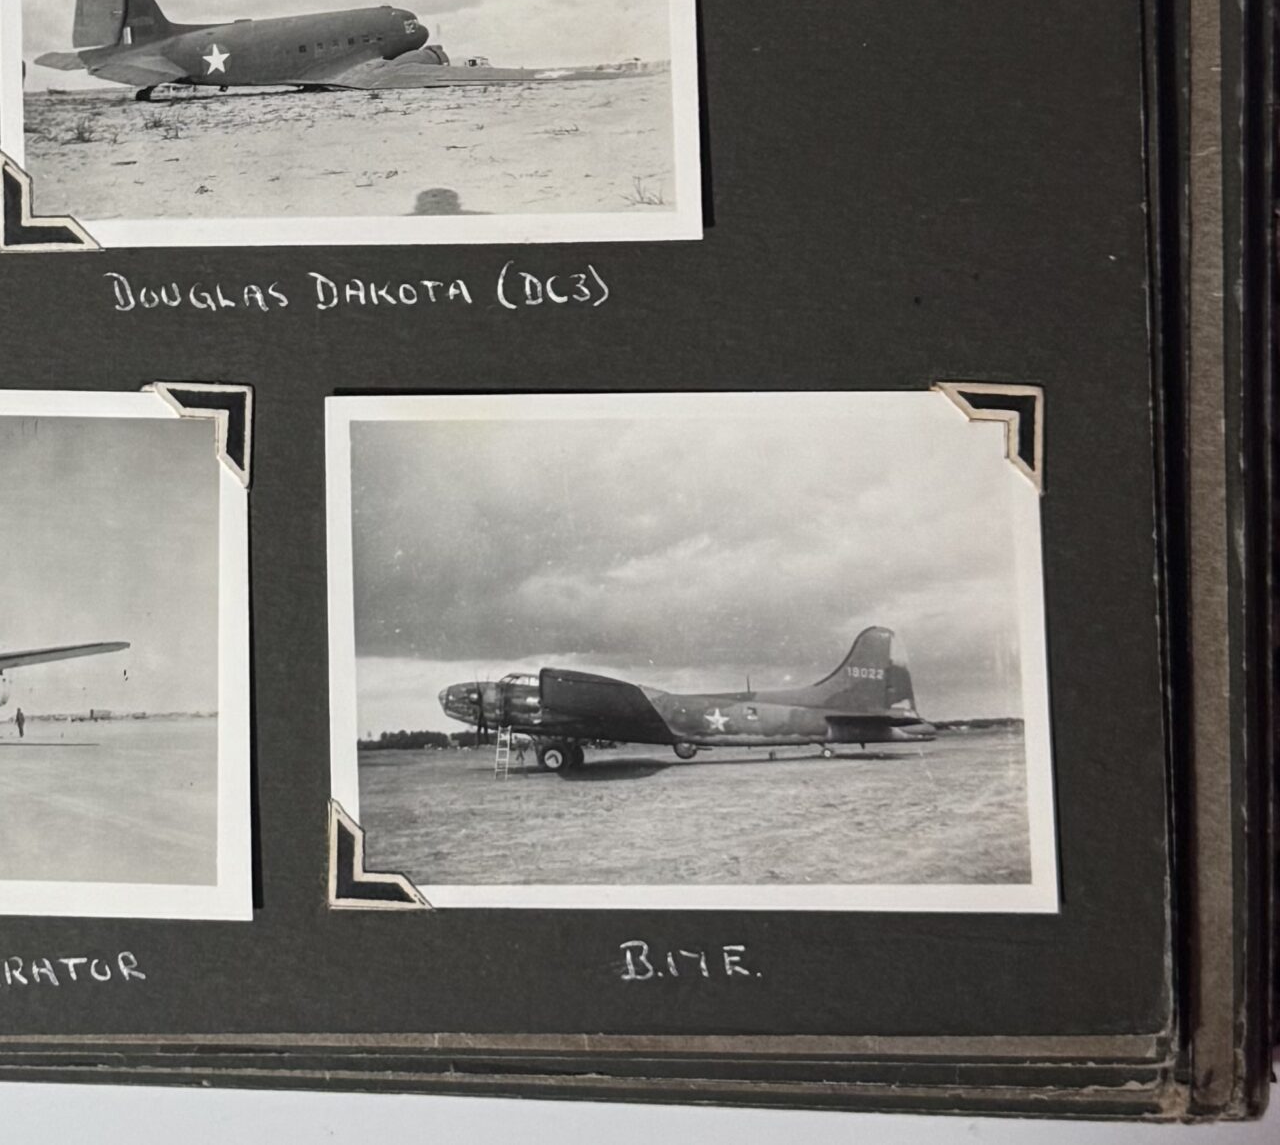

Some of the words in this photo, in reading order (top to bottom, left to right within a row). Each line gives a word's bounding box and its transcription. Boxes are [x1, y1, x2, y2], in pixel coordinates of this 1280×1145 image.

[104, 272, 288, 312] DOUGLAS
[307, 272, 472, 310] DAKOTA
[497, 261, 609, 309] (DC3)
